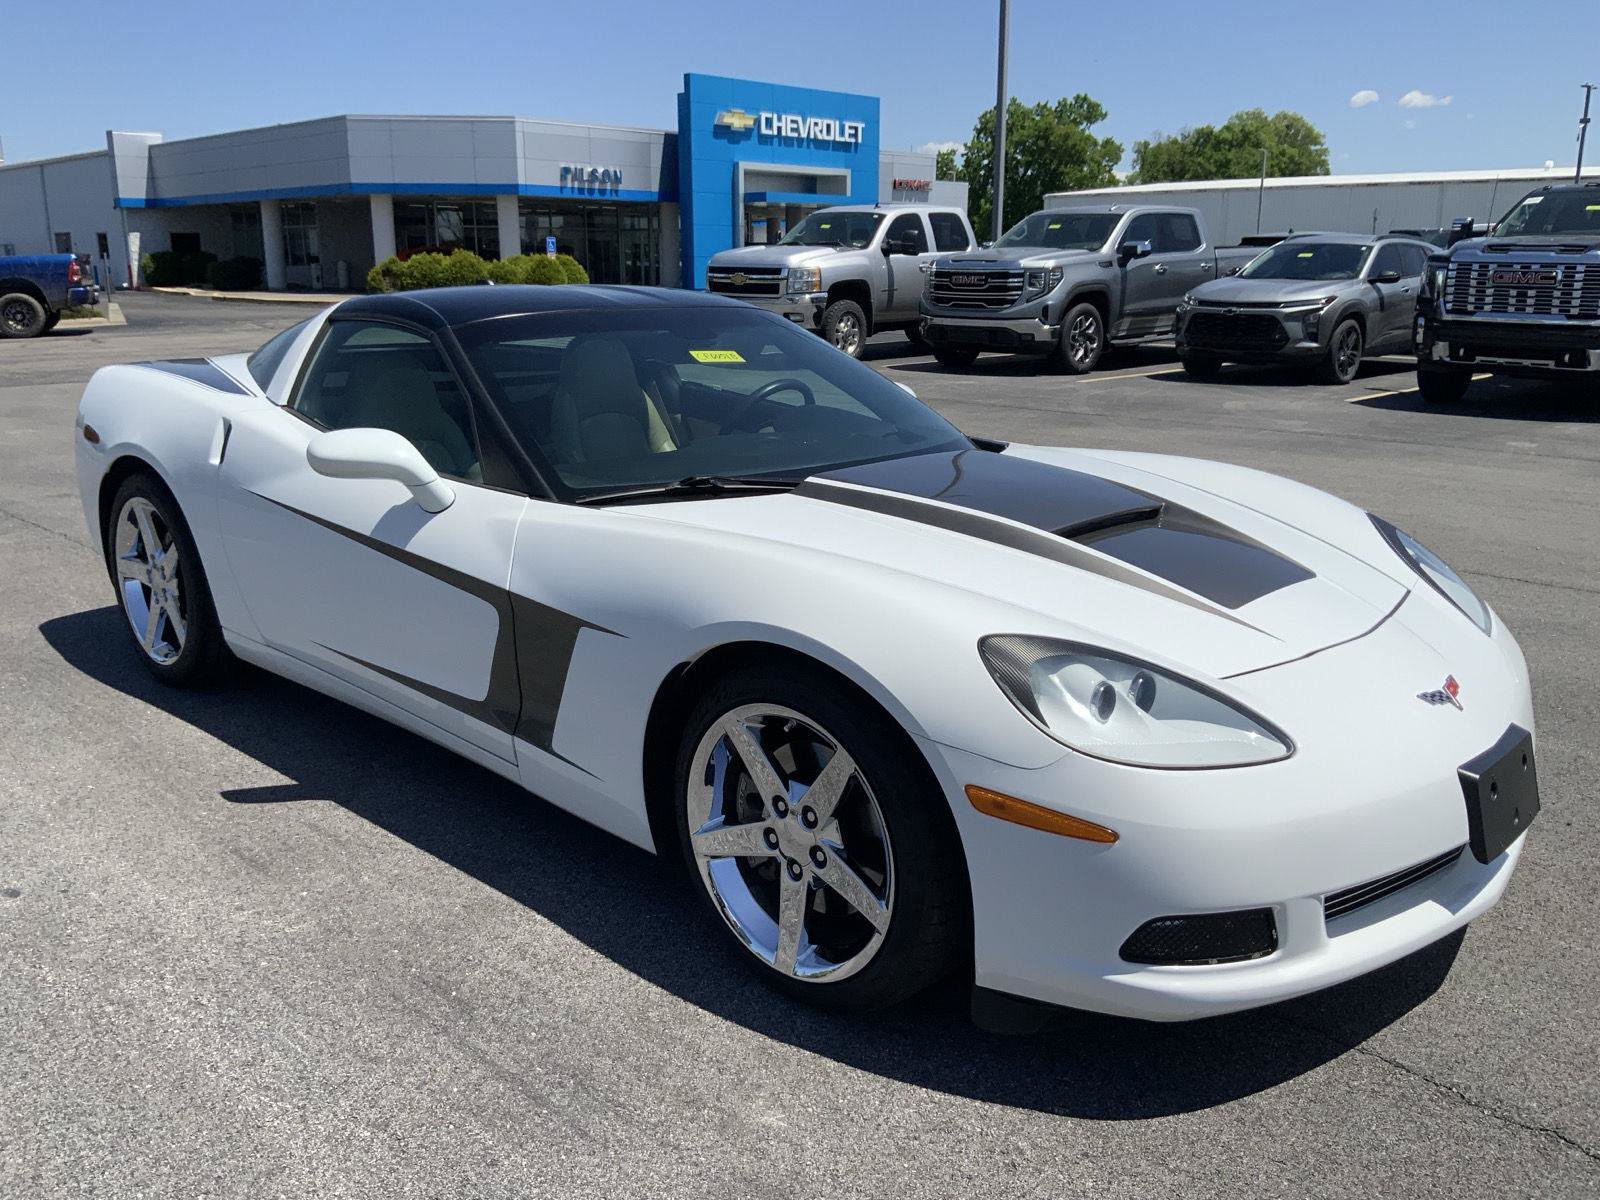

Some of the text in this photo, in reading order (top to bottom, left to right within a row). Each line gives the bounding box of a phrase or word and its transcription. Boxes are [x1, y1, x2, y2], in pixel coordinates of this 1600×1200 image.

[760, 112, 865, 143] CHEVROLET
[951, 275, 986, 285] GMC
[1493, 270, 1556, 285] GMC
